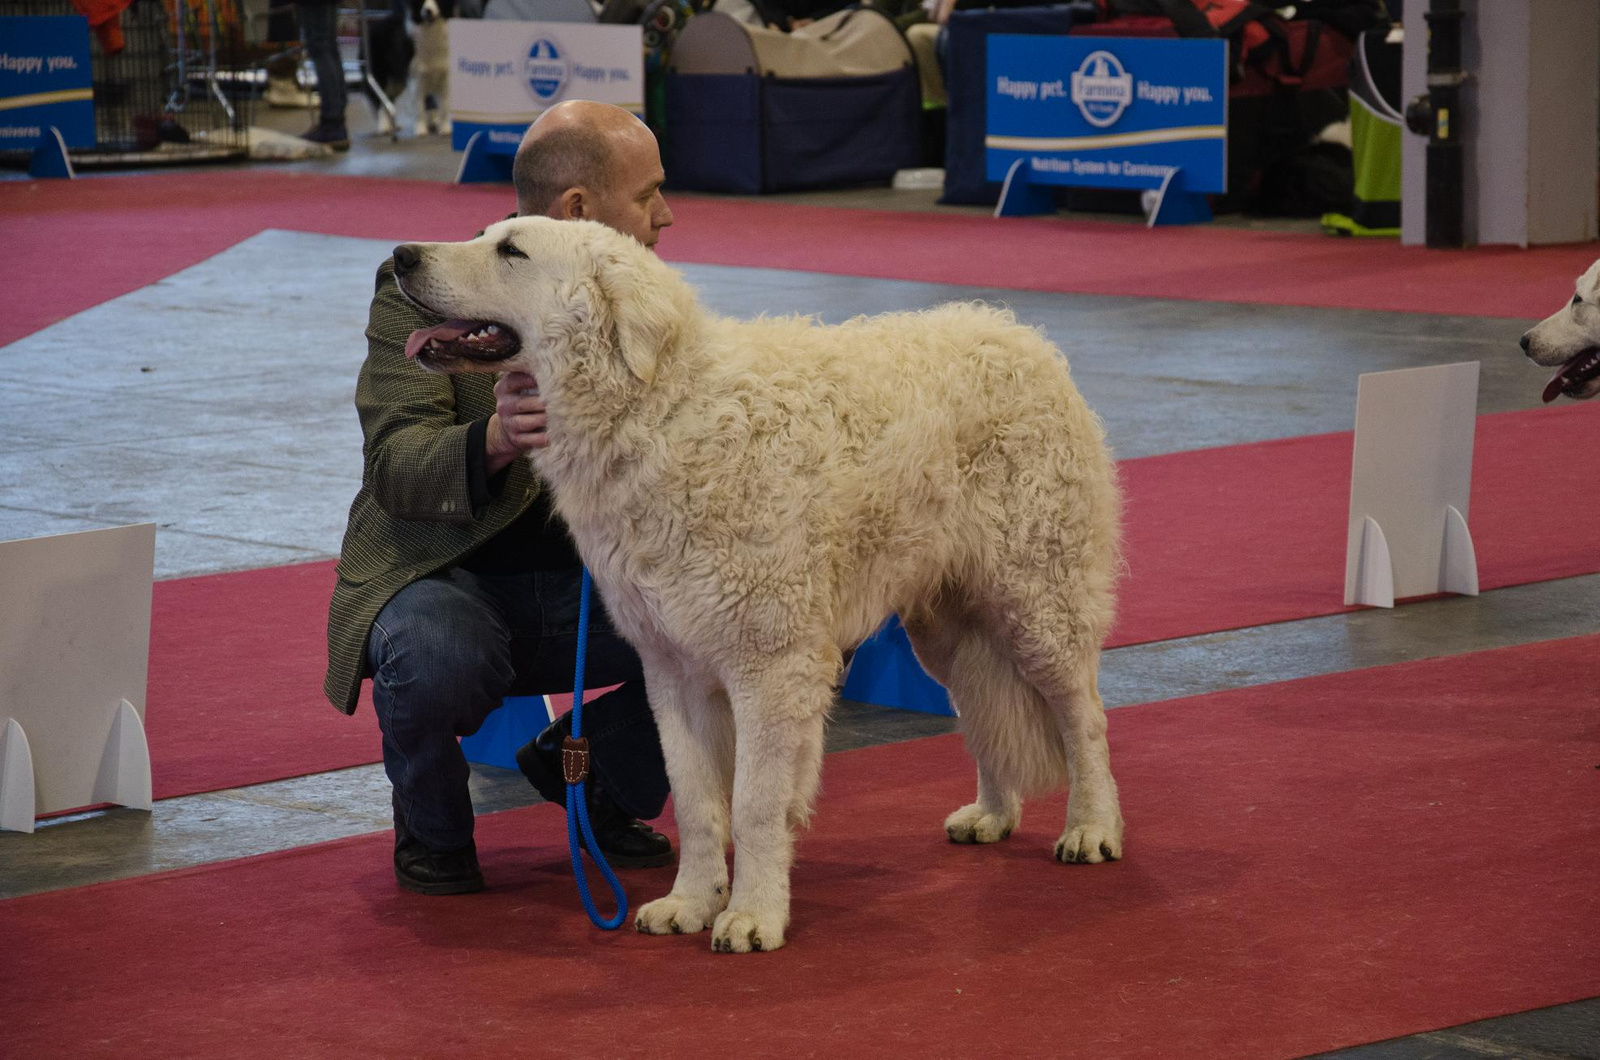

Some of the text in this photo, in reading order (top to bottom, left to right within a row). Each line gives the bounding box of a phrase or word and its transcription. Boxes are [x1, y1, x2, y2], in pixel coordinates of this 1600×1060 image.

[46, 55, 78, 74] you.
[458, 57, 491, 77] Happy
[573, 62, 606, 81] Happy
[997, 76, 1068, 101] Happy pet.
[1137, 81, 1214, 105] Happy you.
[1031, 156, 1072, 173] Nutrition
[1073, 158, 1106, 175] System
[1107, 159, 1121, 176] for
